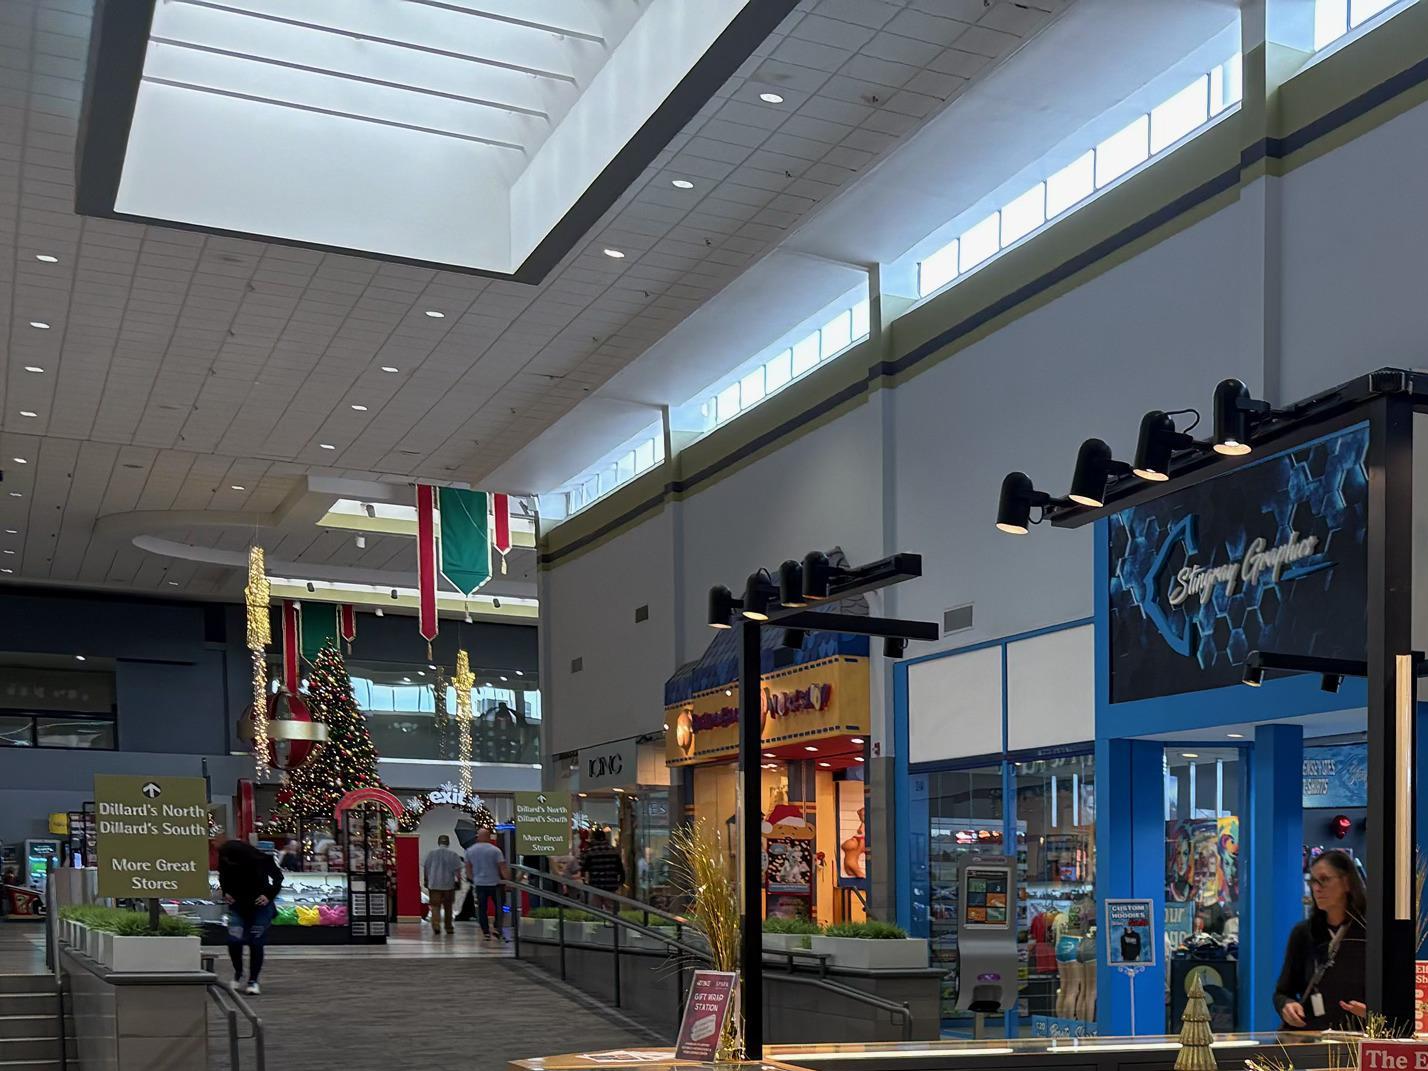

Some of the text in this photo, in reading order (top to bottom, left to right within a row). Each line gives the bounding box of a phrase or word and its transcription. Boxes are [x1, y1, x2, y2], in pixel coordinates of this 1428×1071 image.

[1168, 531, 1319, 605] Stingray Graphics
[430, 789, 467, 805] exit
[99, 802, 205, 818] Dillard's North
[516, 804, 568, 814] Dillard's North
[516, 814, 568, 823] Dillard's South
[100, 821, 206, 836] Dillard's South
[522, 834, 564, 843] More Great
[532, 843, 555, 852] Stores
[112, 858, 197, 872] More Great
[131, 877, 178, 890] Stores
[694, 1003, 719, 1012] STATION
[1366, 1050, 1408, 1069] The
